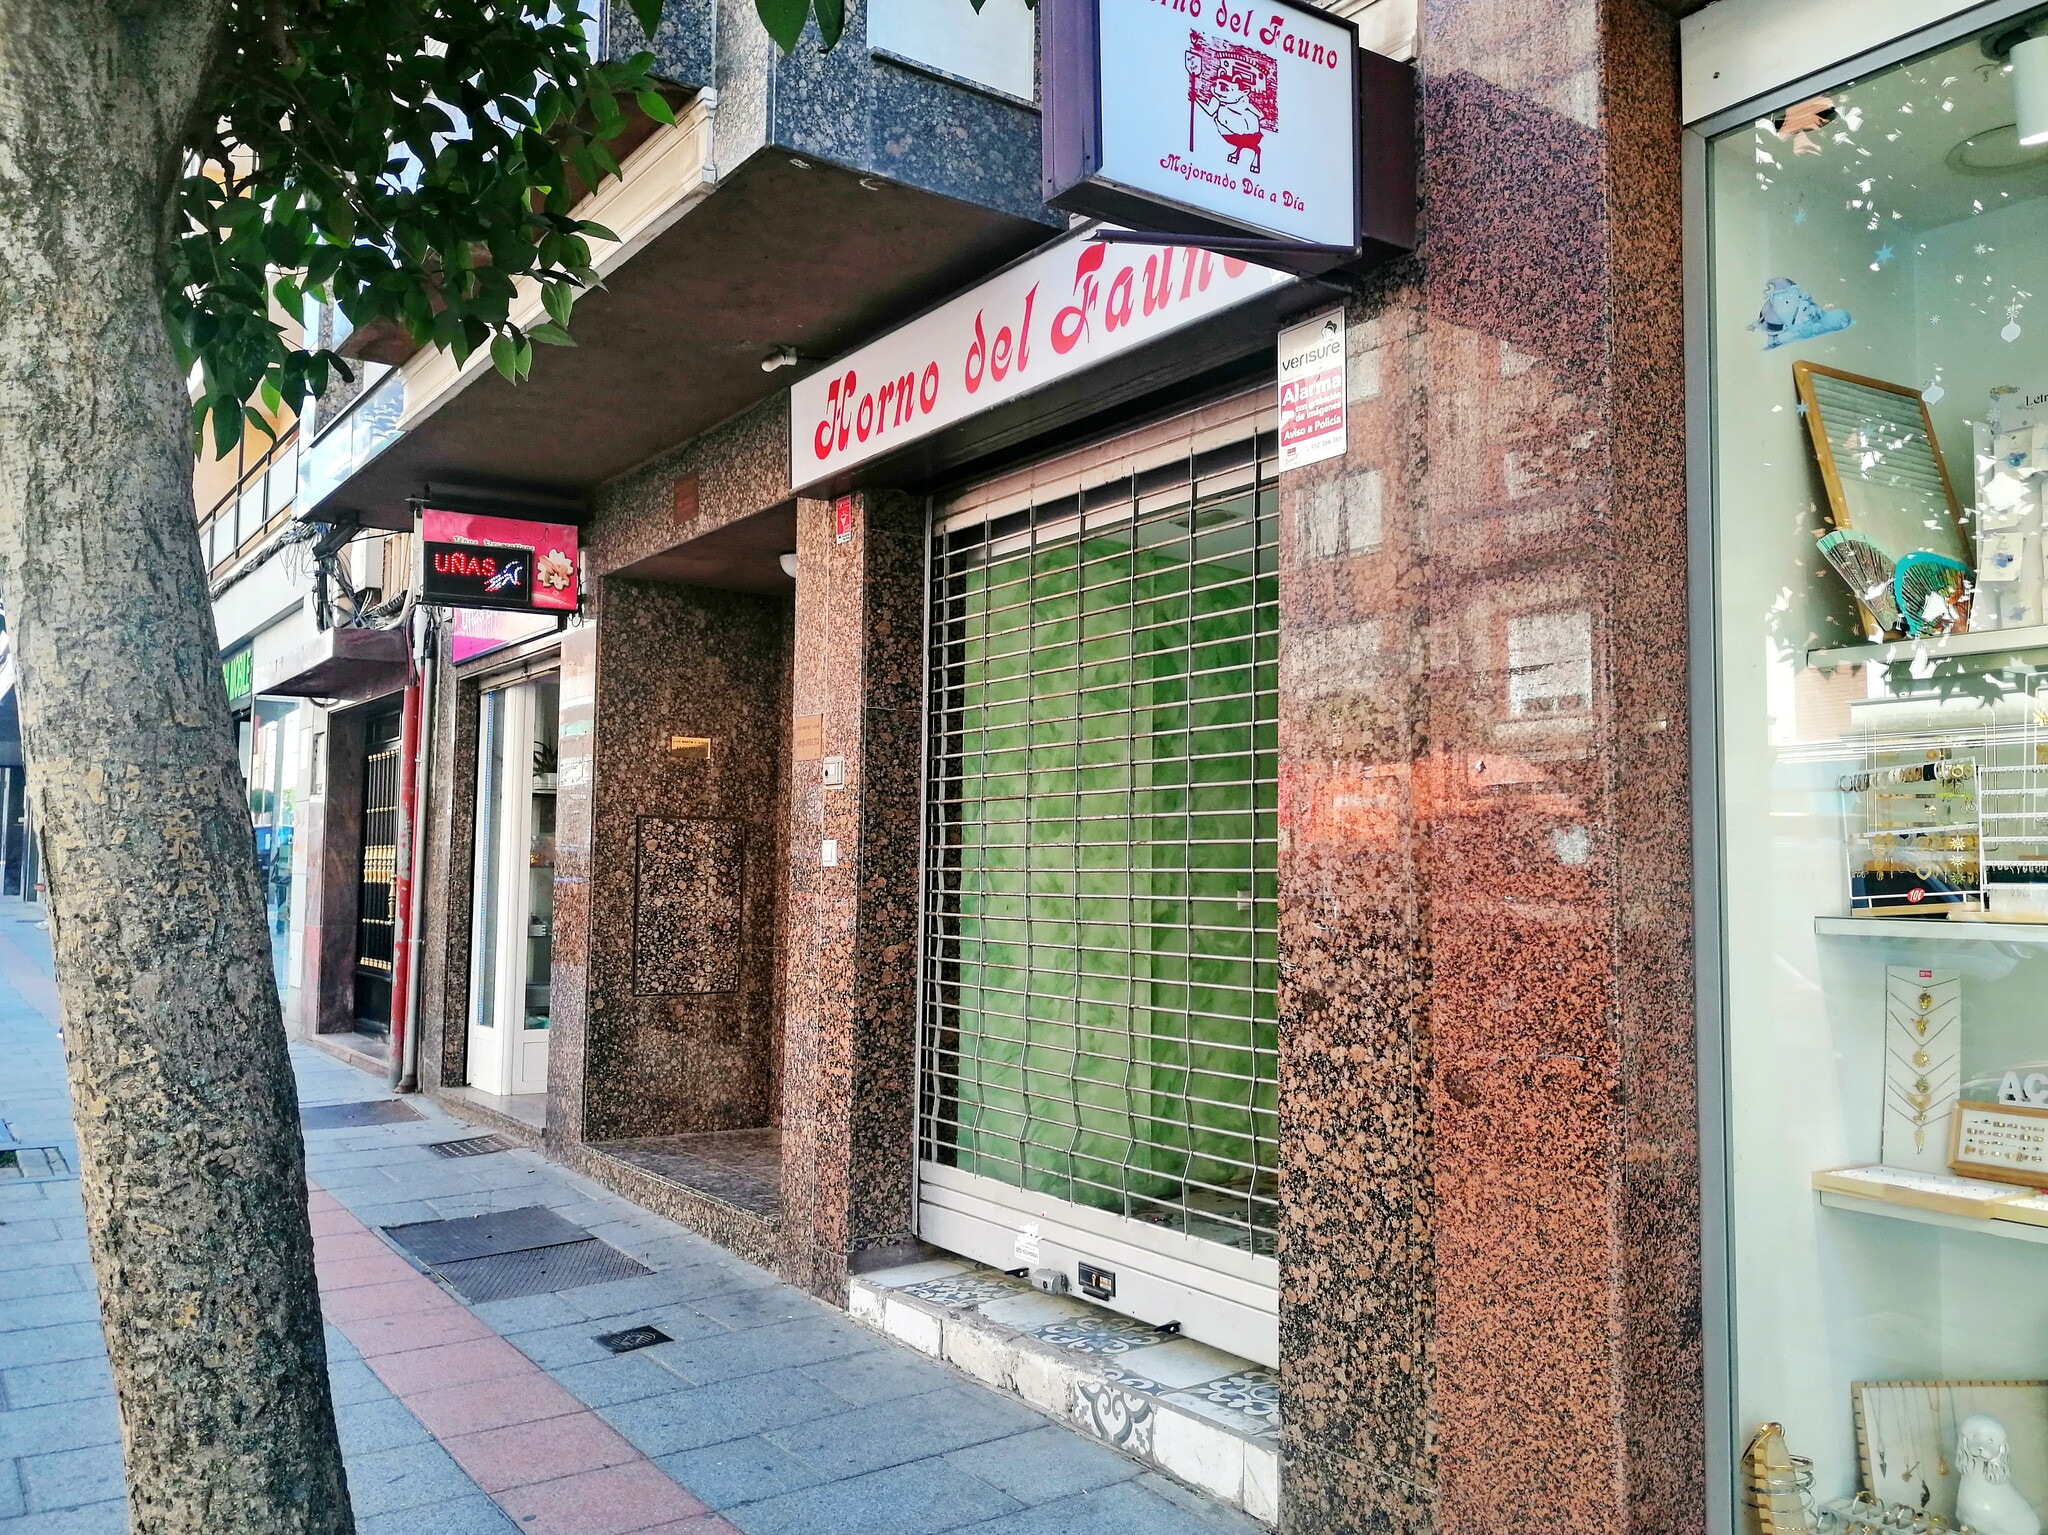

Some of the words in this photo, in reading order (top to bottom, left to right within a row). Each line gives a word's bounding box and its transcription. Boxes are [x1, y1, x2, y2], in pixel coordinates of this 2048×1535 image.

[1215, 0, 1254, 37] del
[1259, 15, 1338, 69] Fauno
[1160, 154, 1237, 190] Mejorando
[1242, 177, 1265, 199] Día
[1269, 192, 1277, 203] a
[1282, 190, 1305, 212] Día
[814, 361, 940, 460] Horno
[965, 281, 1040, 394] del
[1282, 341, 1341, 372] verisure
[1281, 375, 1341, 407] Alarma
[1283, 427, 1306, 441] Aviso
[1307, 425, 1313, 433] a
[1314, 415, 1342, 431] Policía
[1295, 412, 1306, 423] de
[434, 552, 496, 576] UÑAS
[1910, 889, 1925, 901] 10€
